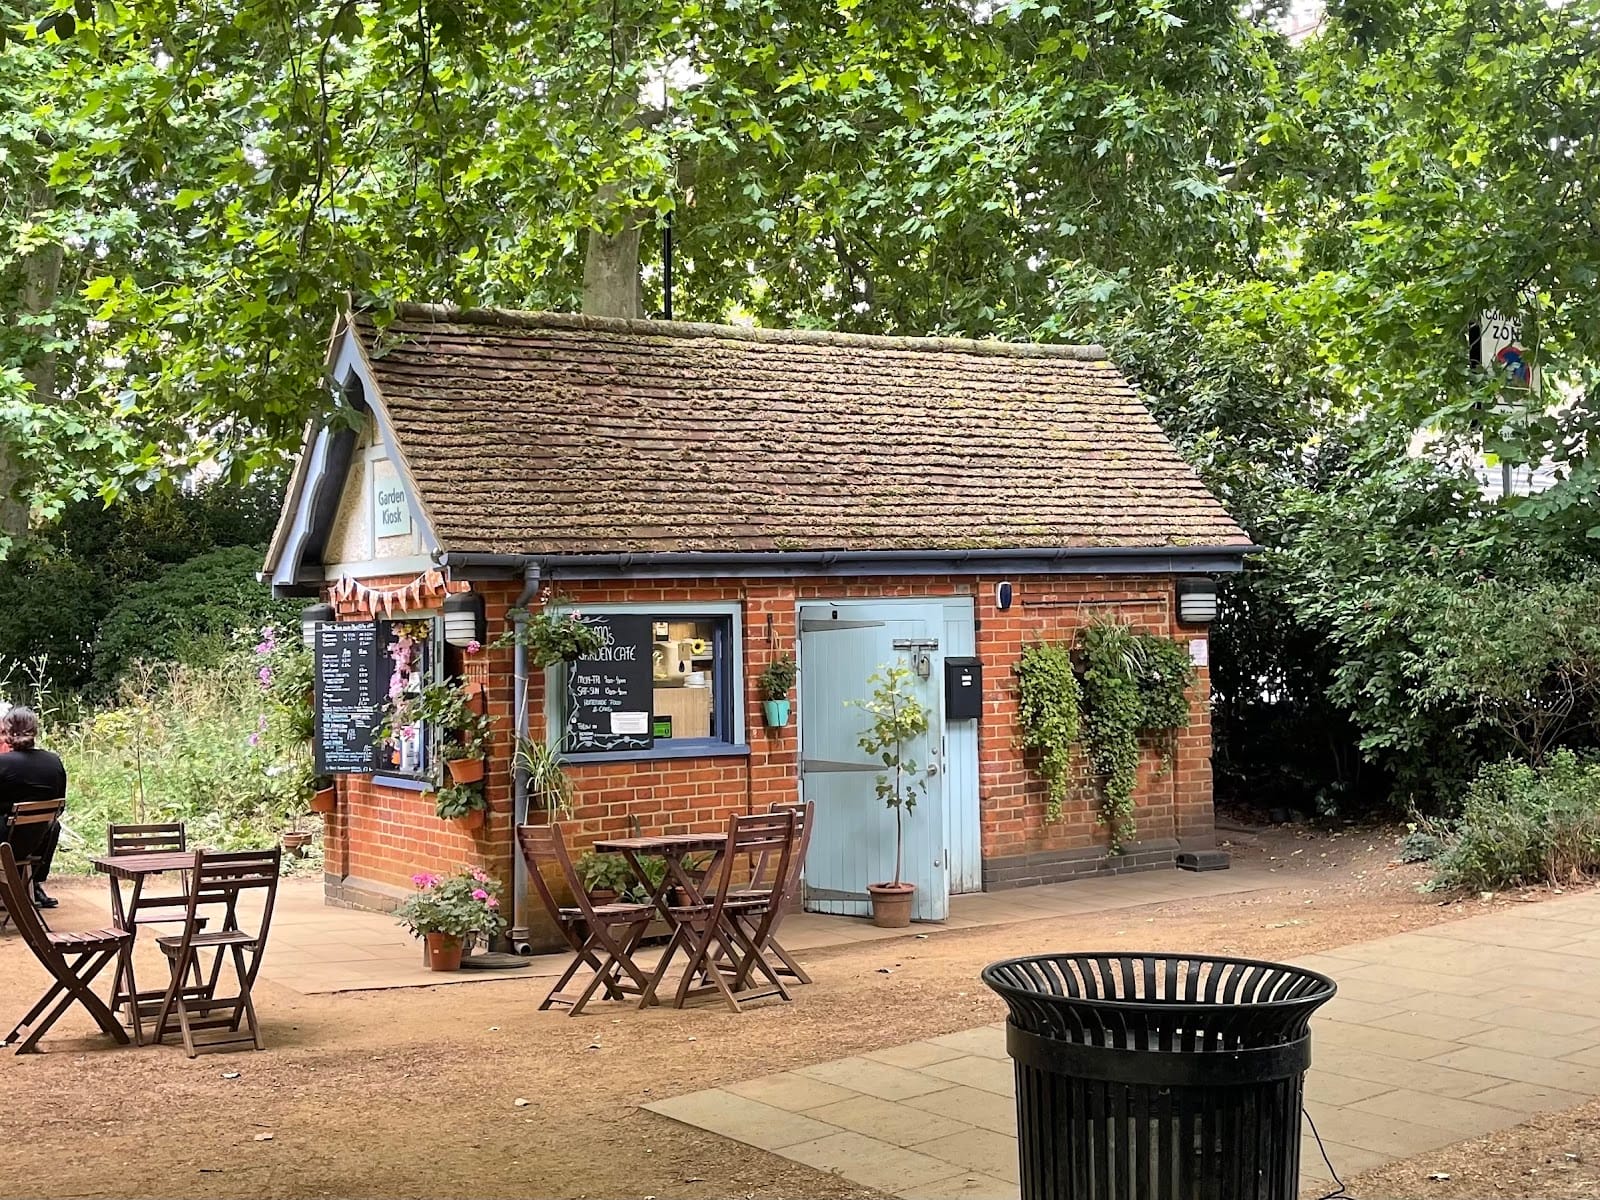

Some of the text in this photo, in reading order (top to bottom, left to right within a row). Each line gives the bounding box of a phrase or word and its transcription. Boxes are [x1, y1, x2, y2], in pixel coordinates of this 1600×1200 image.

[1493, 325, 1521, 342] ZON
[378, 488, 405, 506] Garden
[382, 506, 402, 525] Kiosk
